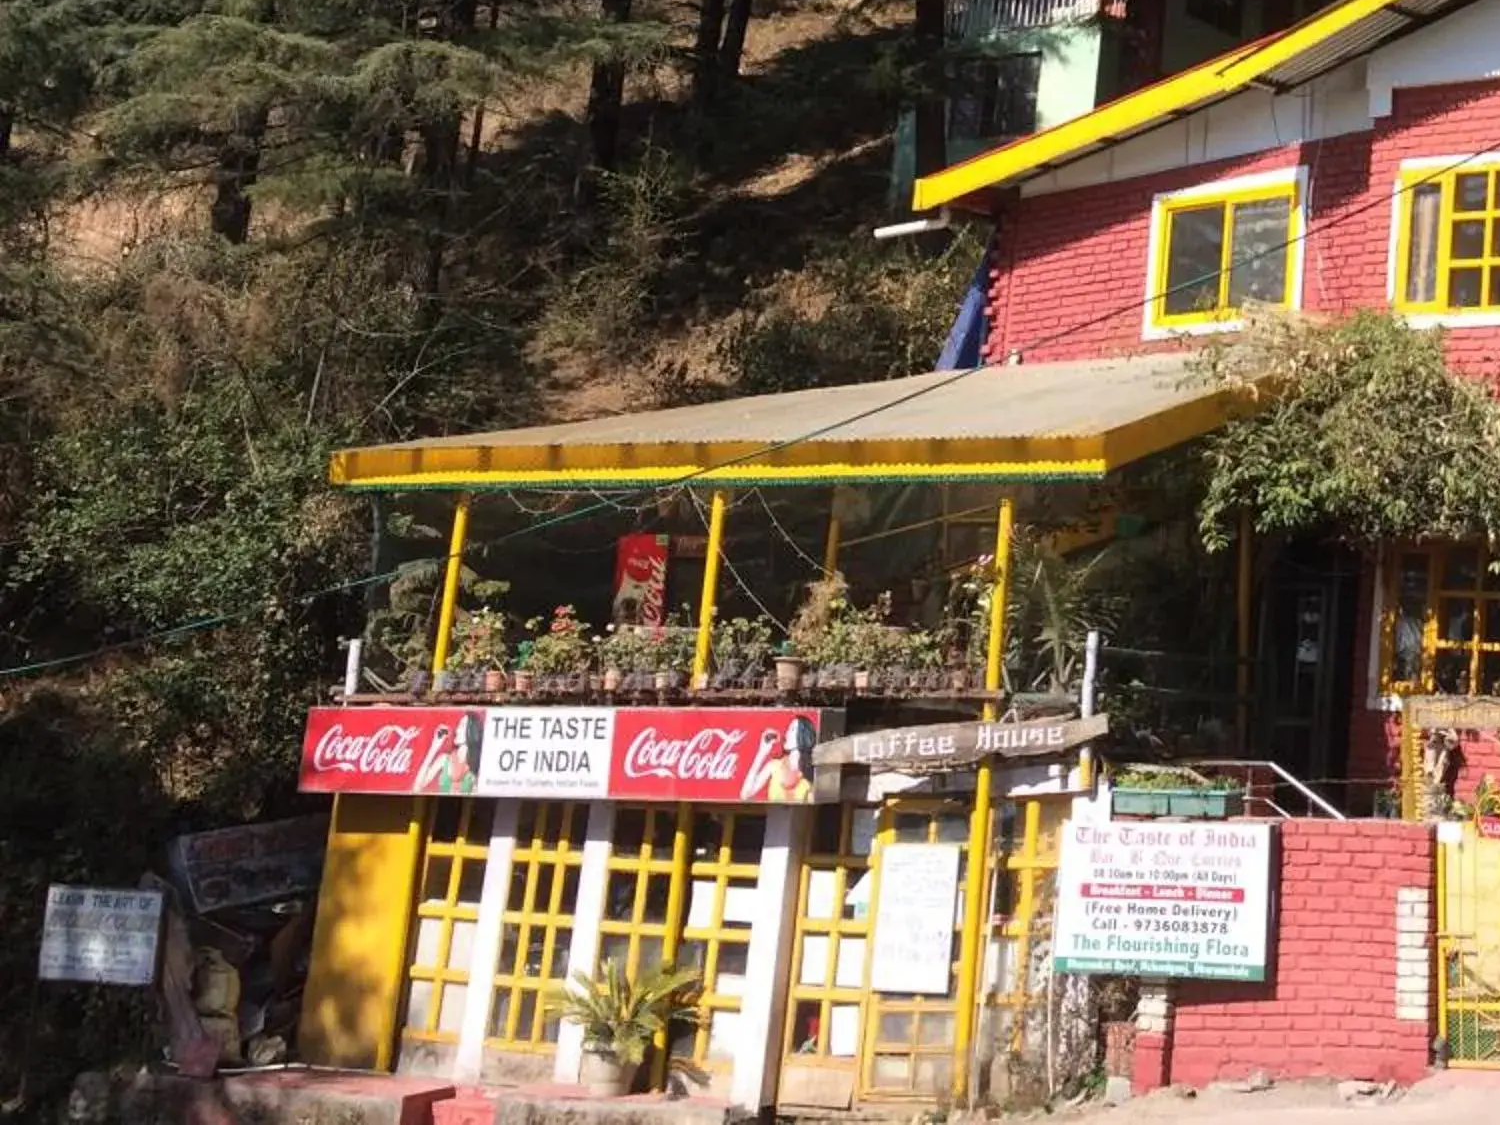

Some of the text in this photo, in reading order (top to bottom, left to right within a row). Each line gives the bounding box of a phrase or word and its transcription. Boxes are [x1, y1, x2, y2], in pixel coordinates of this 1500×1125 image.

[492, 717, 607, 740] THE TASTE
[314, 724, 421, 773] Coca-Cola
[624, 726, 747, 780] Coca-Cola
[853, 724, 1065, 762] Coffee House
[499, 750, 591, 773] OF INDIA
[1075, 826, 1257, 848] The Taste of India
[1136, 869, 1146, 880] to
[92, 894, 113, 908] THE
[1085, 901, 1238, 921] (Free Home Delivery)
[1092, 918, 1117, 931] Call
[1072, 934, 1249, 959] The Flourishing Flora
